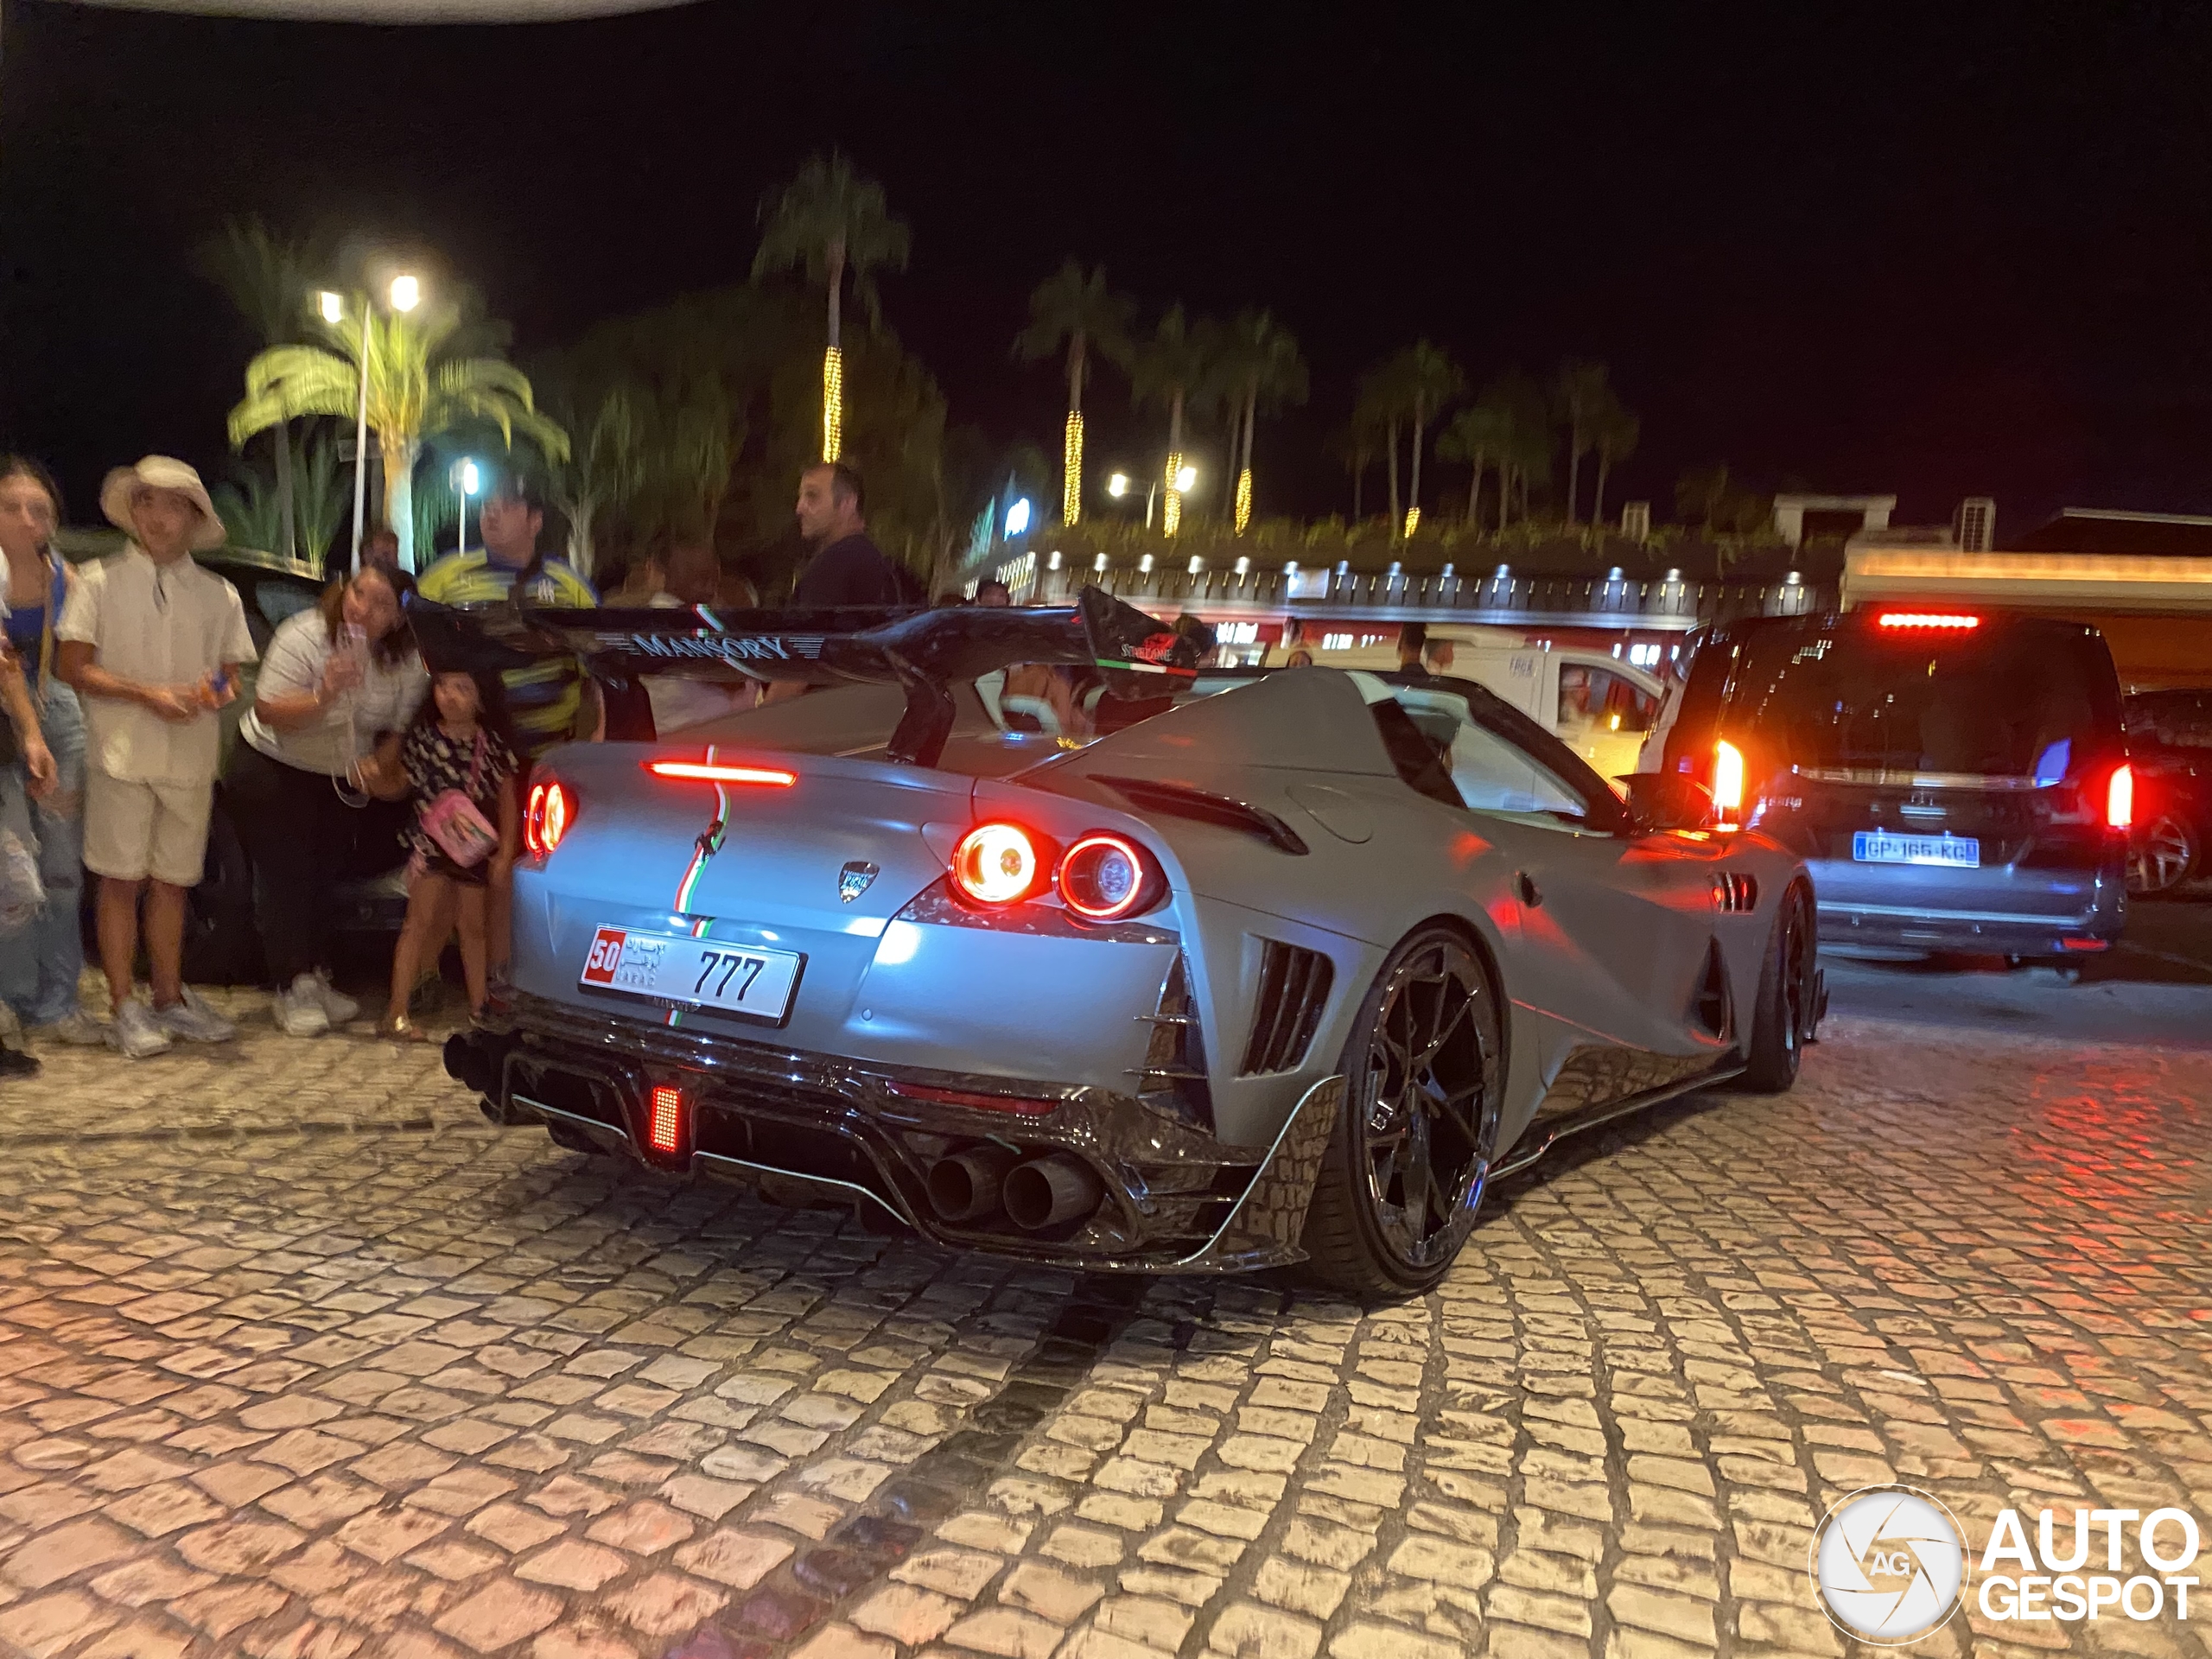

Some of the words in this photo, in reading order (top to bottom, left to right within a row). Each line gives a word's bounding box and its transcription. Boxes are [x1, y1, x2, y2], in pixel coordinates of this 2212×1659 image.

[632, 633, 790, 660] MANSORY
[589, 939, 620, 973] 50
[694, 951, 765, 1001] 777
